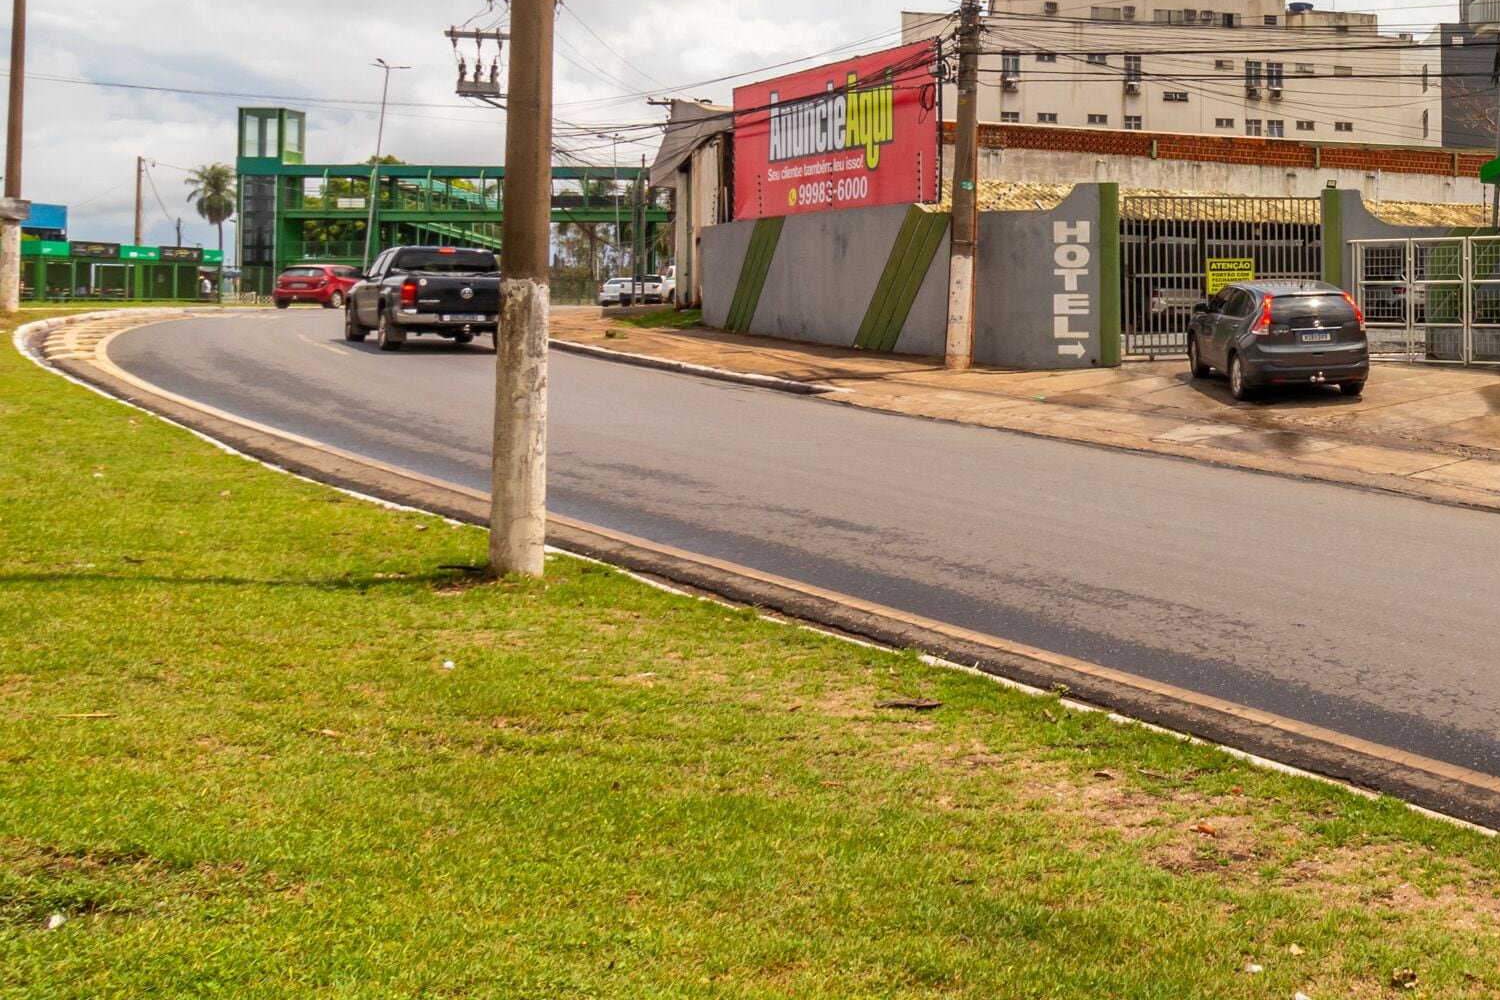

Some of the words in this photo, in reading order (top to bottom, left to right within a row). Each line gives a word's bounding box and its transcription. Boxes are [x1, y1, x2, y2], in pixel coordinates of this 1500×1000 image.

[767, 168, 780, 182] Seu
[781, 164, 802, 179] cliente
[803, 160, 832, 176] também
[833, 158, 845, 172] leu
[845, 154, 864, 170] isso!
[798, 175, 868, 206] 99983-6000
[1053, 220, 1091, 338] HOTEL
[1210, 261, 1250, 270] ATENÇÃO
